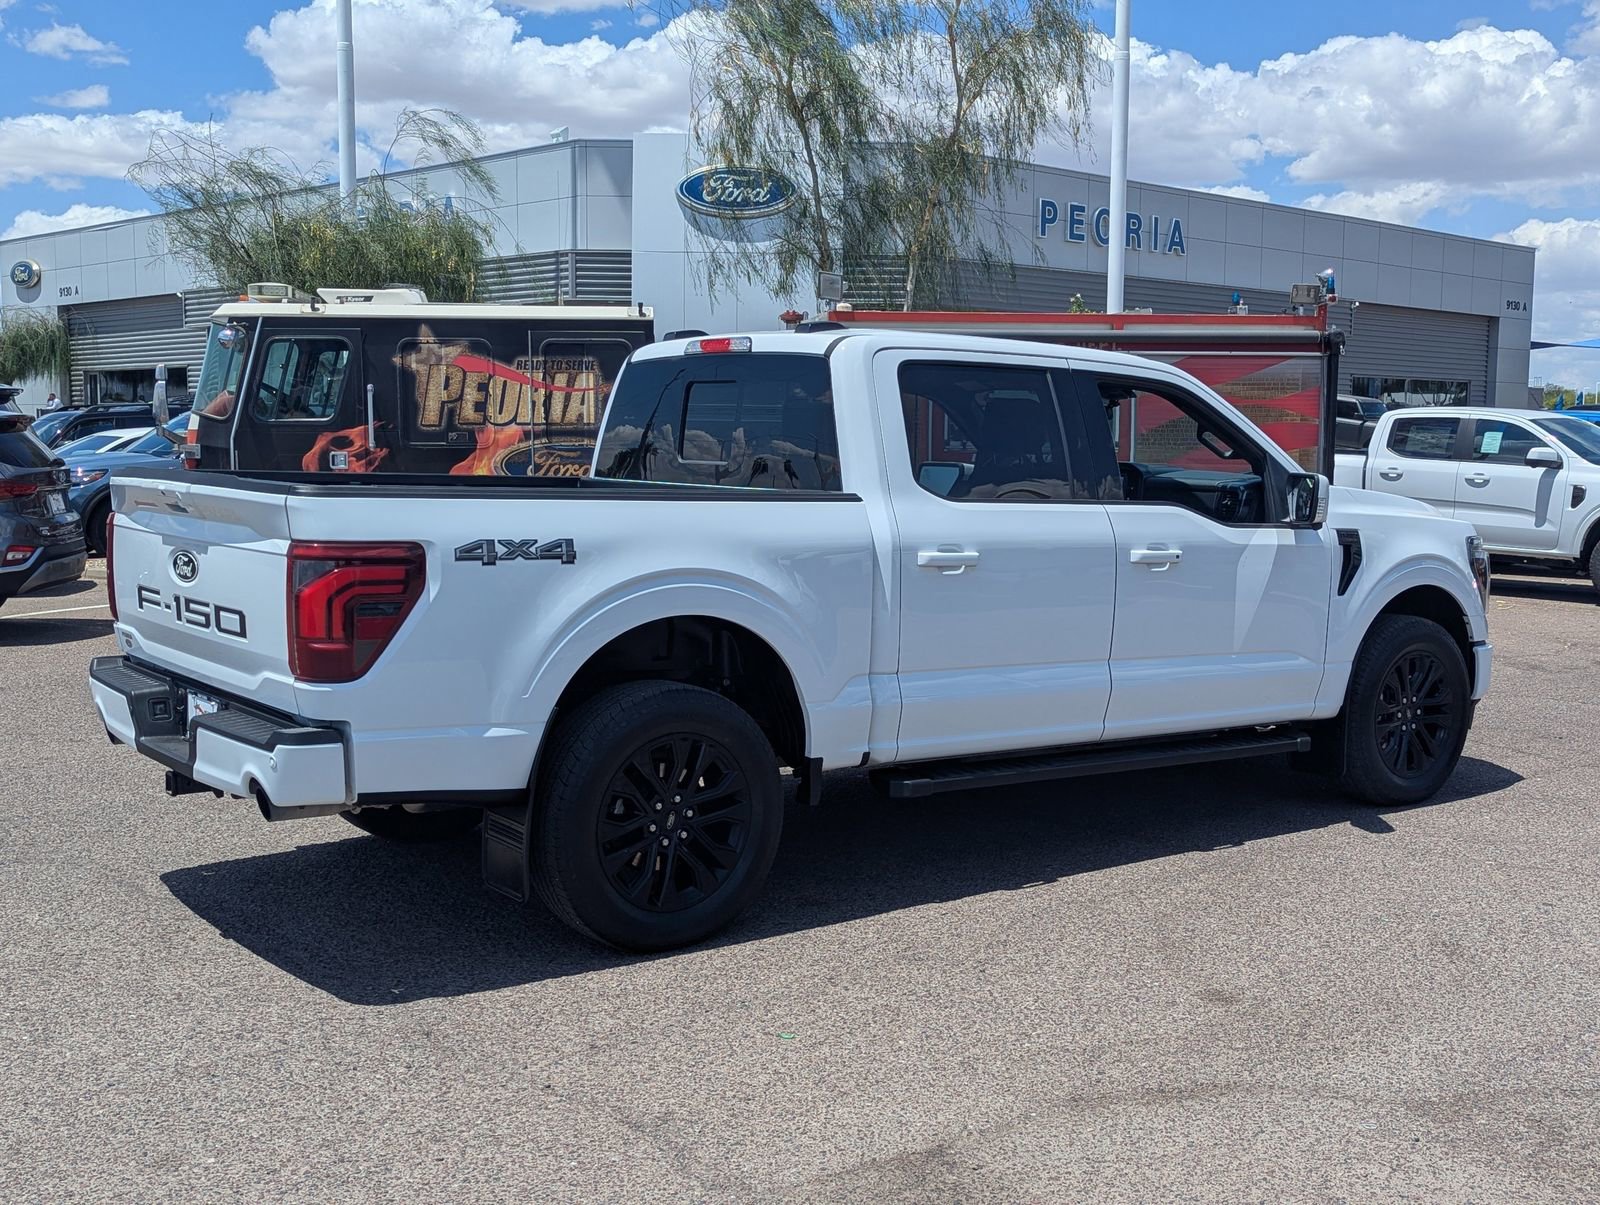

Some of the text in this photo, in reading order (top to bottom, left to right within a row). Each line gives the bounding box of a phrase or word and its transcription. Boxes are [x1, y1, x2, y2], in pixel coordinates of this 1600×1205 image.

[702, 174, 772, 202] Ford
[1038, 198, 1186, 255] PEORIA
[14, 266, 29, 281] Ford
[59, 286, 79, 297] 9130 A
[1506, 300, 1527, 312] 9130 A
[516, 359, 596, 371] READY TO SERVE
[420, 364, 596, 426] PEORIA
[175, 555, 194, 577] Ford
[136, 584, 247, 640] F-150
